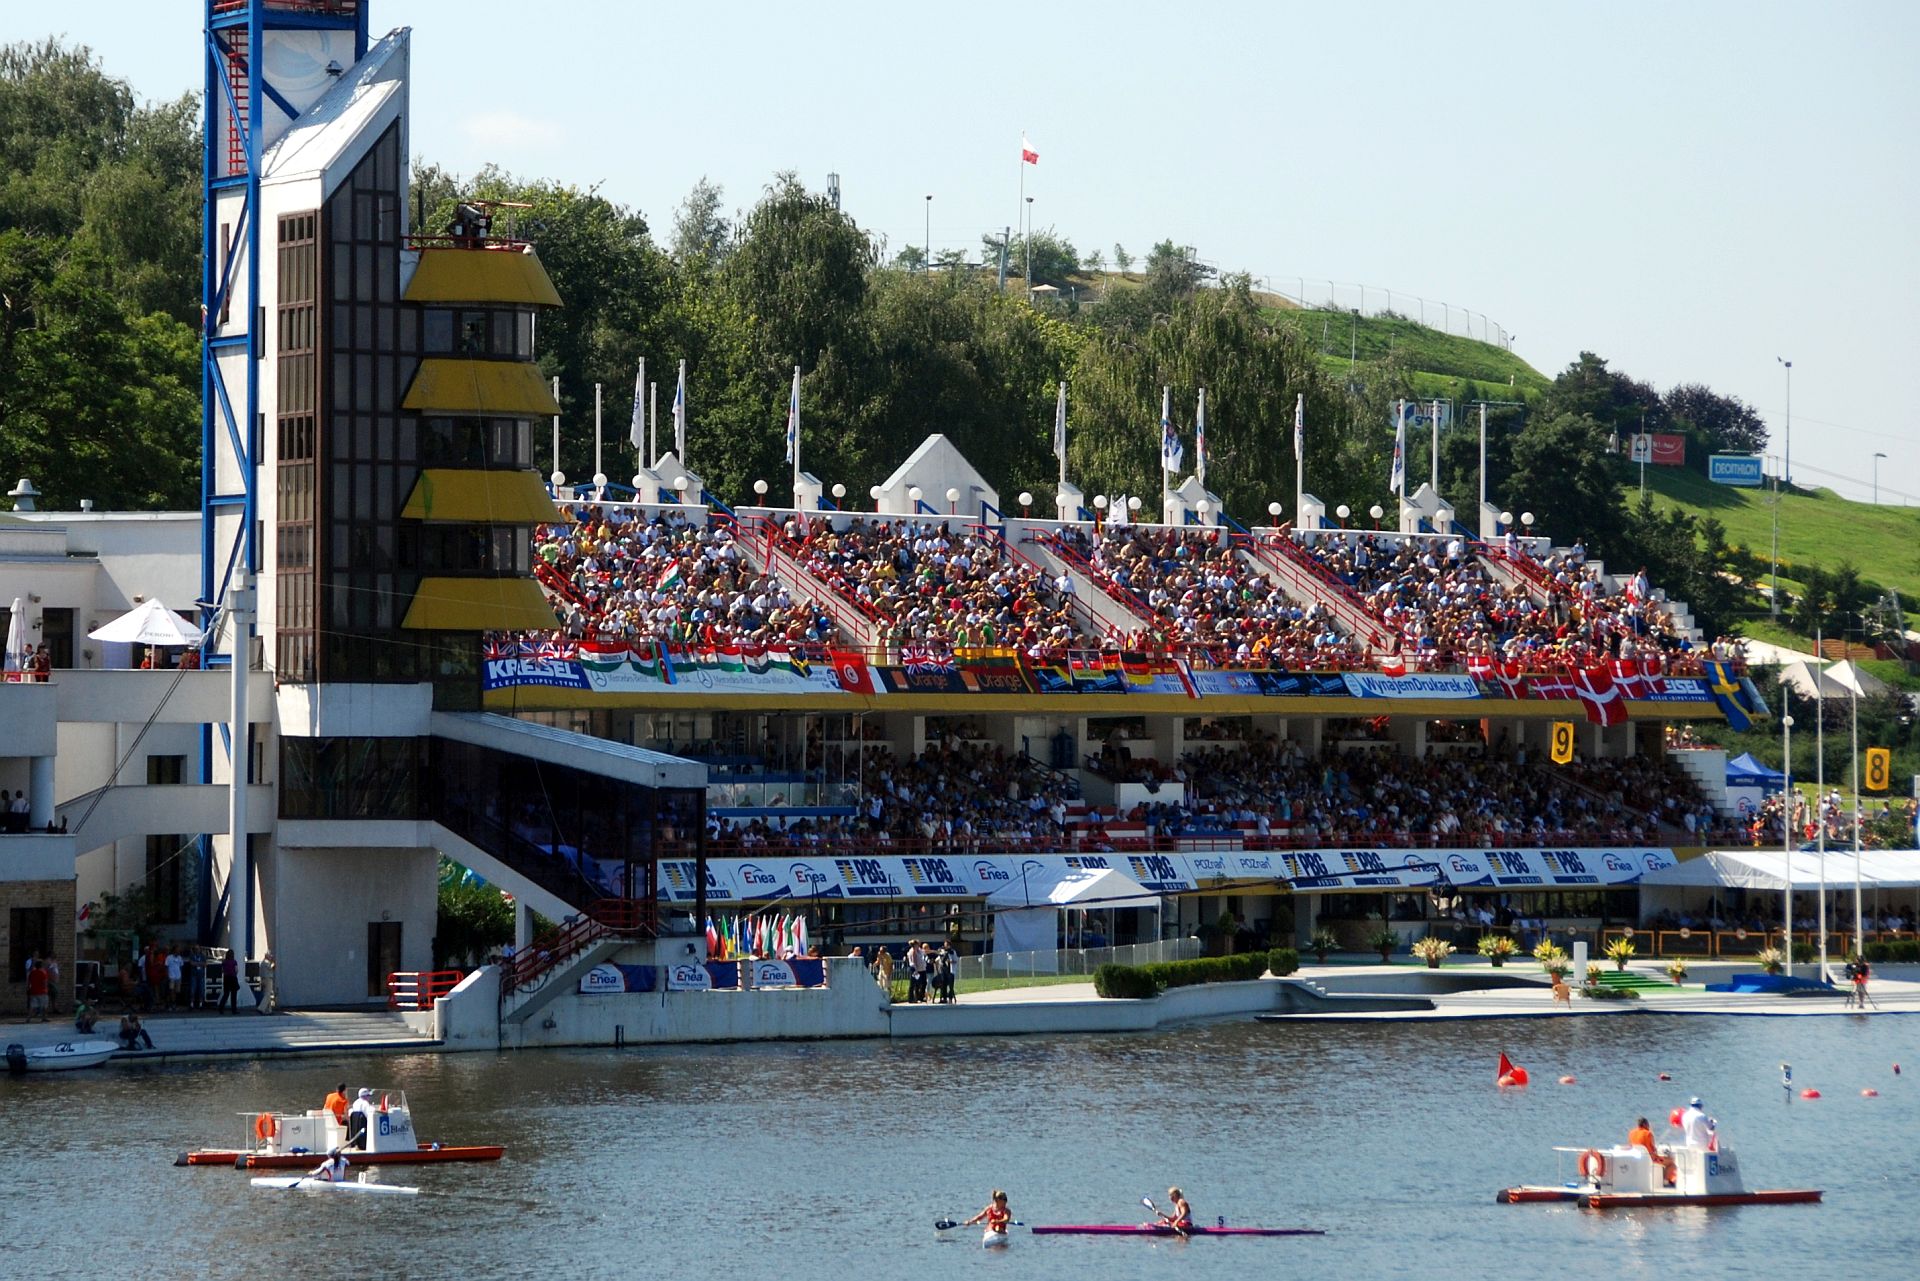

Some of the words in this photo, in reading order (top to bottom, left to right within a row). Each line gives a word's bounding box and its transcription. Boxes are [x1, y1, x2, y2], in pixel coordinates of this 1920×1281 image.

[1361, 676, 1477, 694] WynajemDrukarek.pl
[1557, 727, 1569, 756] 9
[1871, 754, 1884, 784] 8
[1146, 855, 1177, 880] PBG
[1299, 852, 1328, 877] PBG
[1451, 861, 1480, 873] Enea
[1500, 851, 1530, 875] PBG
[1557, 850, 1586, 875] PBG
[1606, 860, 1633, 872] Enea
[744, 871, 776, 884] Enea
[795, 871, 827, 884] Enea
[853, 859, 887, 885] PBG
[920, 858, 954, 883] PBG
[979, 868, 1010, 881] Enea
[590, 973, 617, 984] Enea
[677, 970, 703, 982] Enea
[762, 970, 787, 980] Enea
[381, 1121, 388, 1134] 6
[1710, 1160, 1717, 1176] 5
[1218, 1215, 1224, 1225] 5
